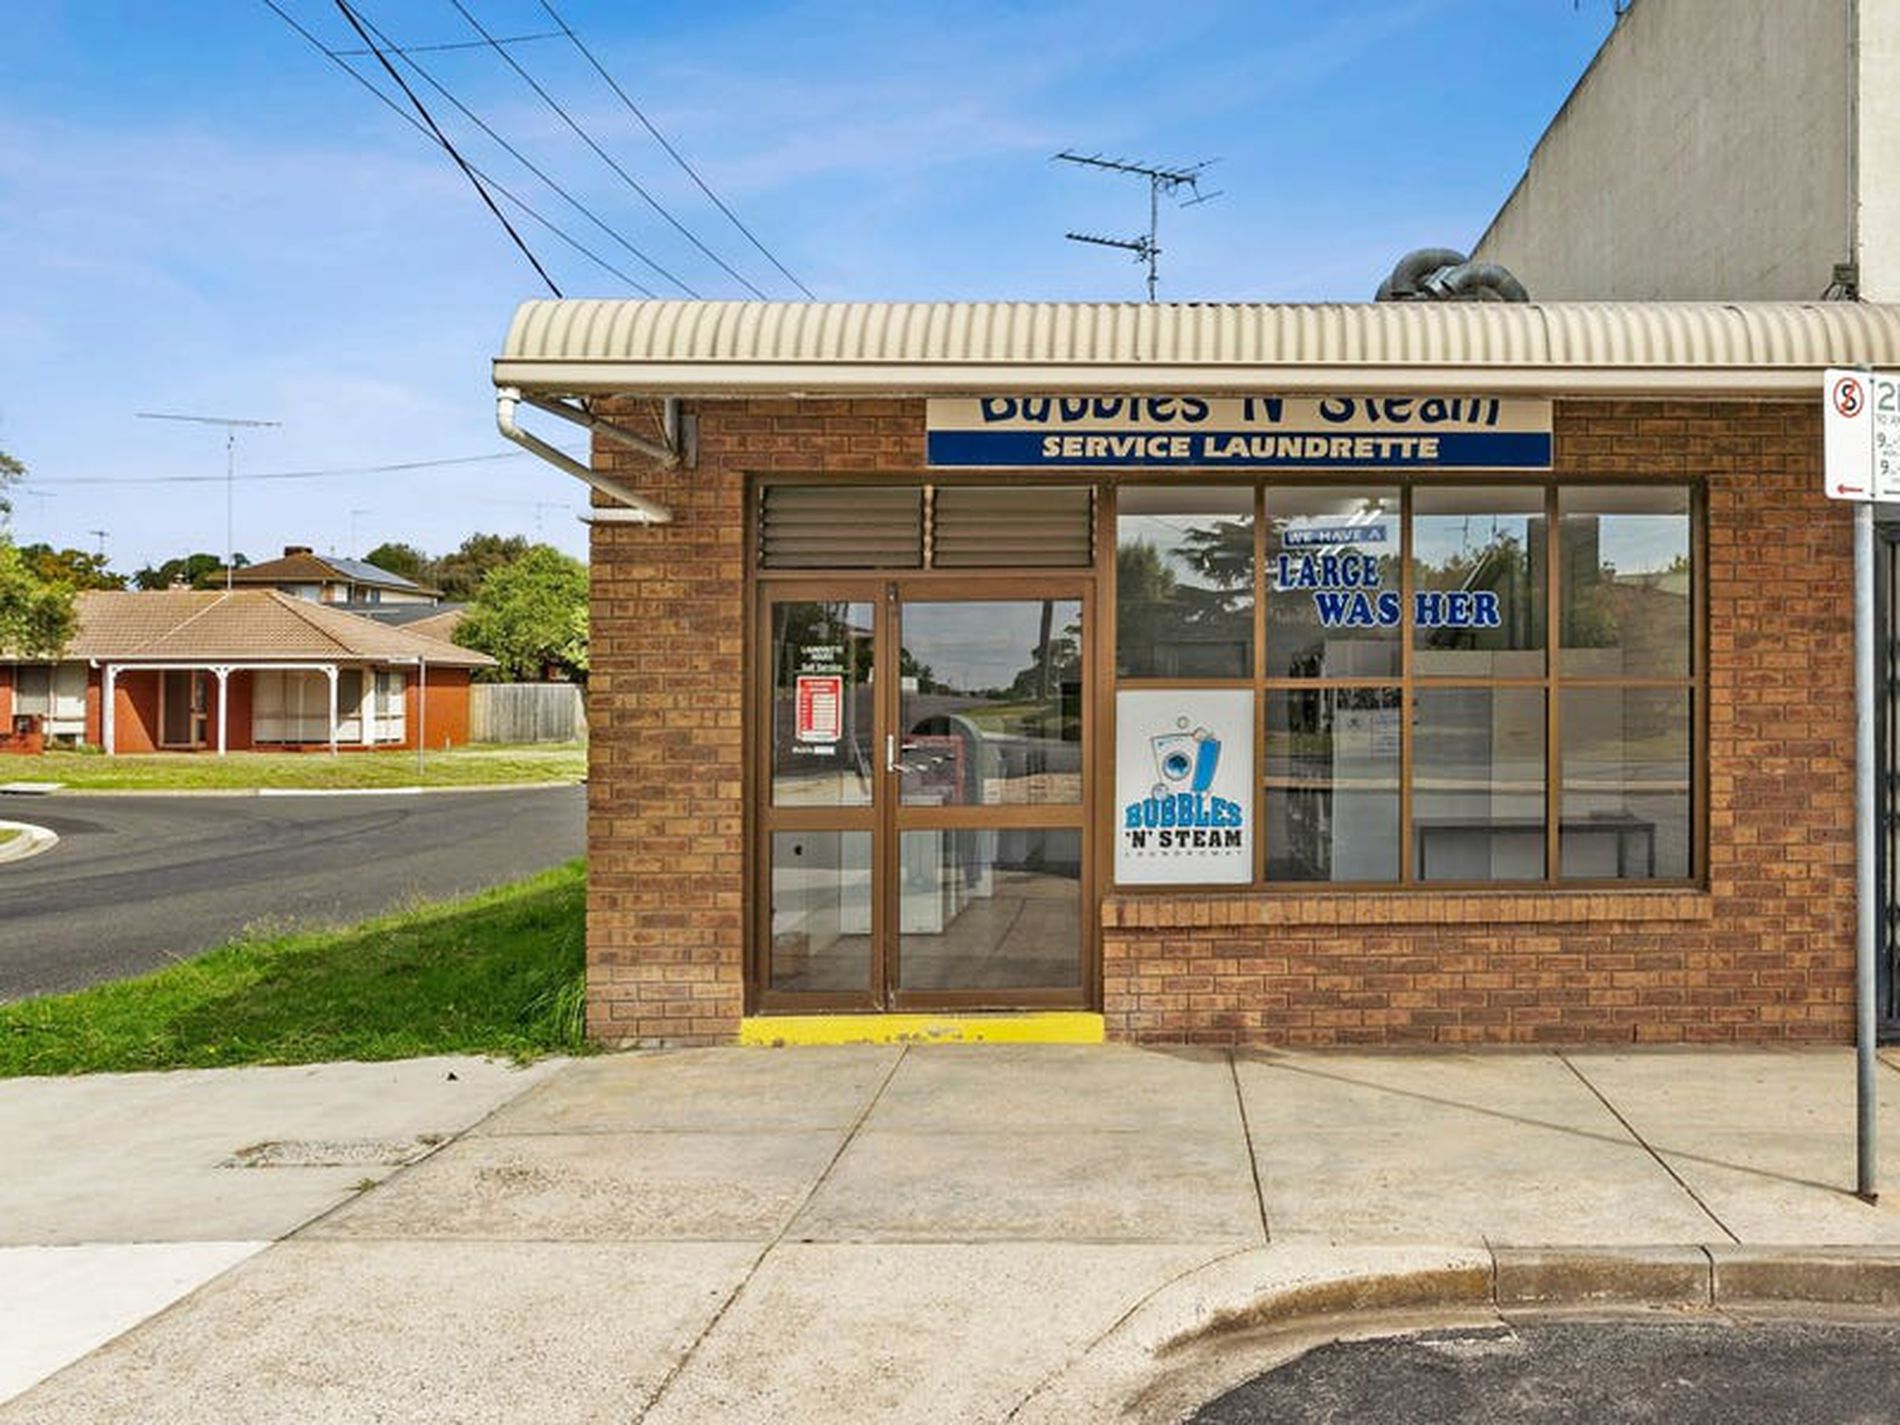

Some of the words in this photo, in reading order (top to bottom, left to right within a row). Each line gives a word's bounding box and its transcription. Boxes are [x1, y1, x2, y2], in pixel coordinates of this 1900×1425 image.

[1878, 382, 1900, 412] 2
[1042, 435, 1191, 460] SERVICE
[1203, 435, 1440, 460] LAUNDRETTE
[1287, 530, 1310, 543] WE
[1319, 529, 1362, 542] HAVE
[1369, 528, 1381, 540] A
[1278, 554, 1380, 589] LARGE
[1125, 792, 1243, 828] BUBBLES
[1125, 830, 1153, 848] 'N'
[1159, 830, 1242, 848] STEAM
